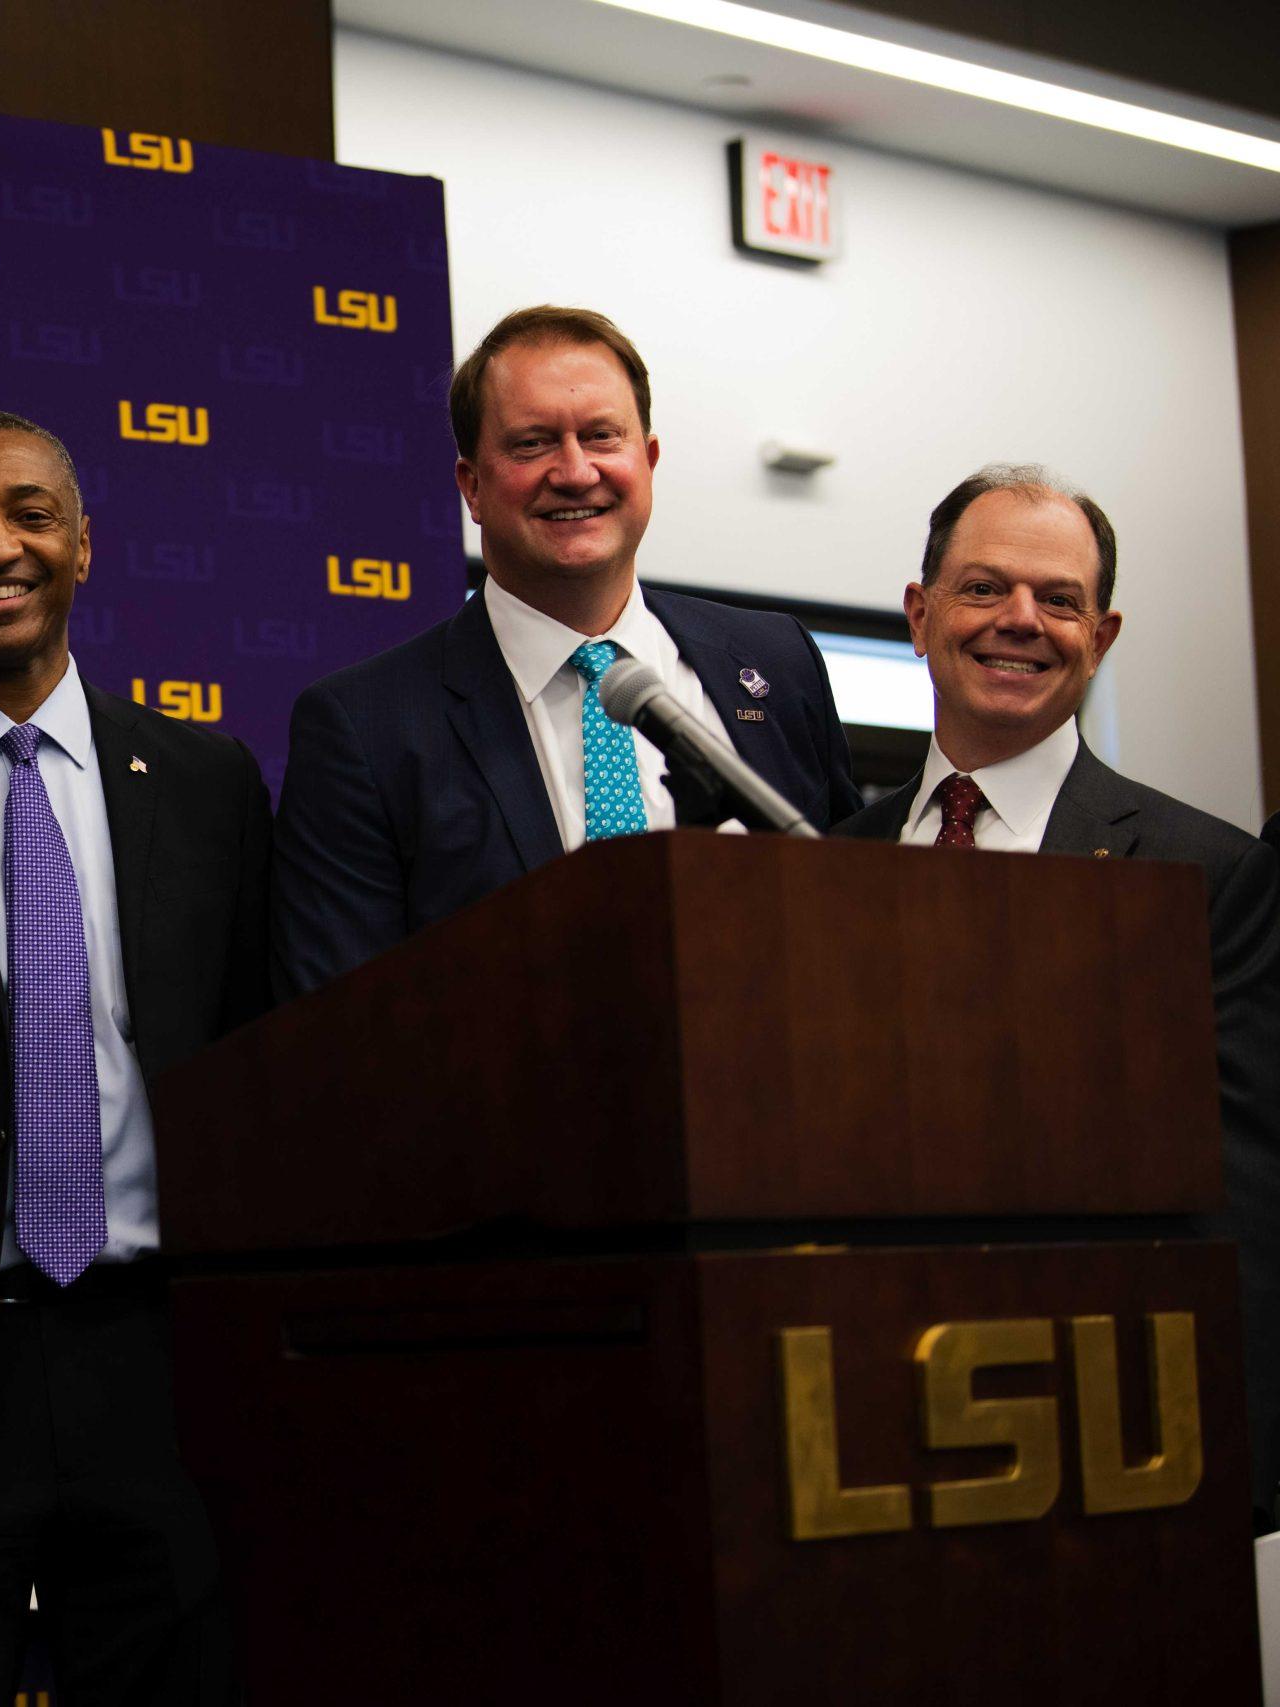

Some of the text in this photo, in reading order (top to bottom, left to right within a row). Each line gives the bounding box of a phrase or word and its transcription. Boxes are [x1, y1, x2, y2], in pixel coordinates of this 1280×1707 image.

[102, 128, 193, 173] LSU
[1, 183, 94, 226] LSU
[762, 152, 830, 246] EXIT
[213, 207, 297, 252] LSU
[114, 260, 201, 307] LSU
[313, 286, 397, 332] LSU
[10, 319, 104, 367] LSU
[219, 342, 305, 386] LSU
[119, 400, 209, 446] LSU
[322, 422, 405, 465] LSU
[227, 482, 313, 523] LSU
[127, 540, 215, 582] LSU
[327, 555, 411, 600] LSU
[233, 616, 317, 659] LSU
[736, 709, 765, 721] LSU
[781, 1311, 1204, 1541] LSU
